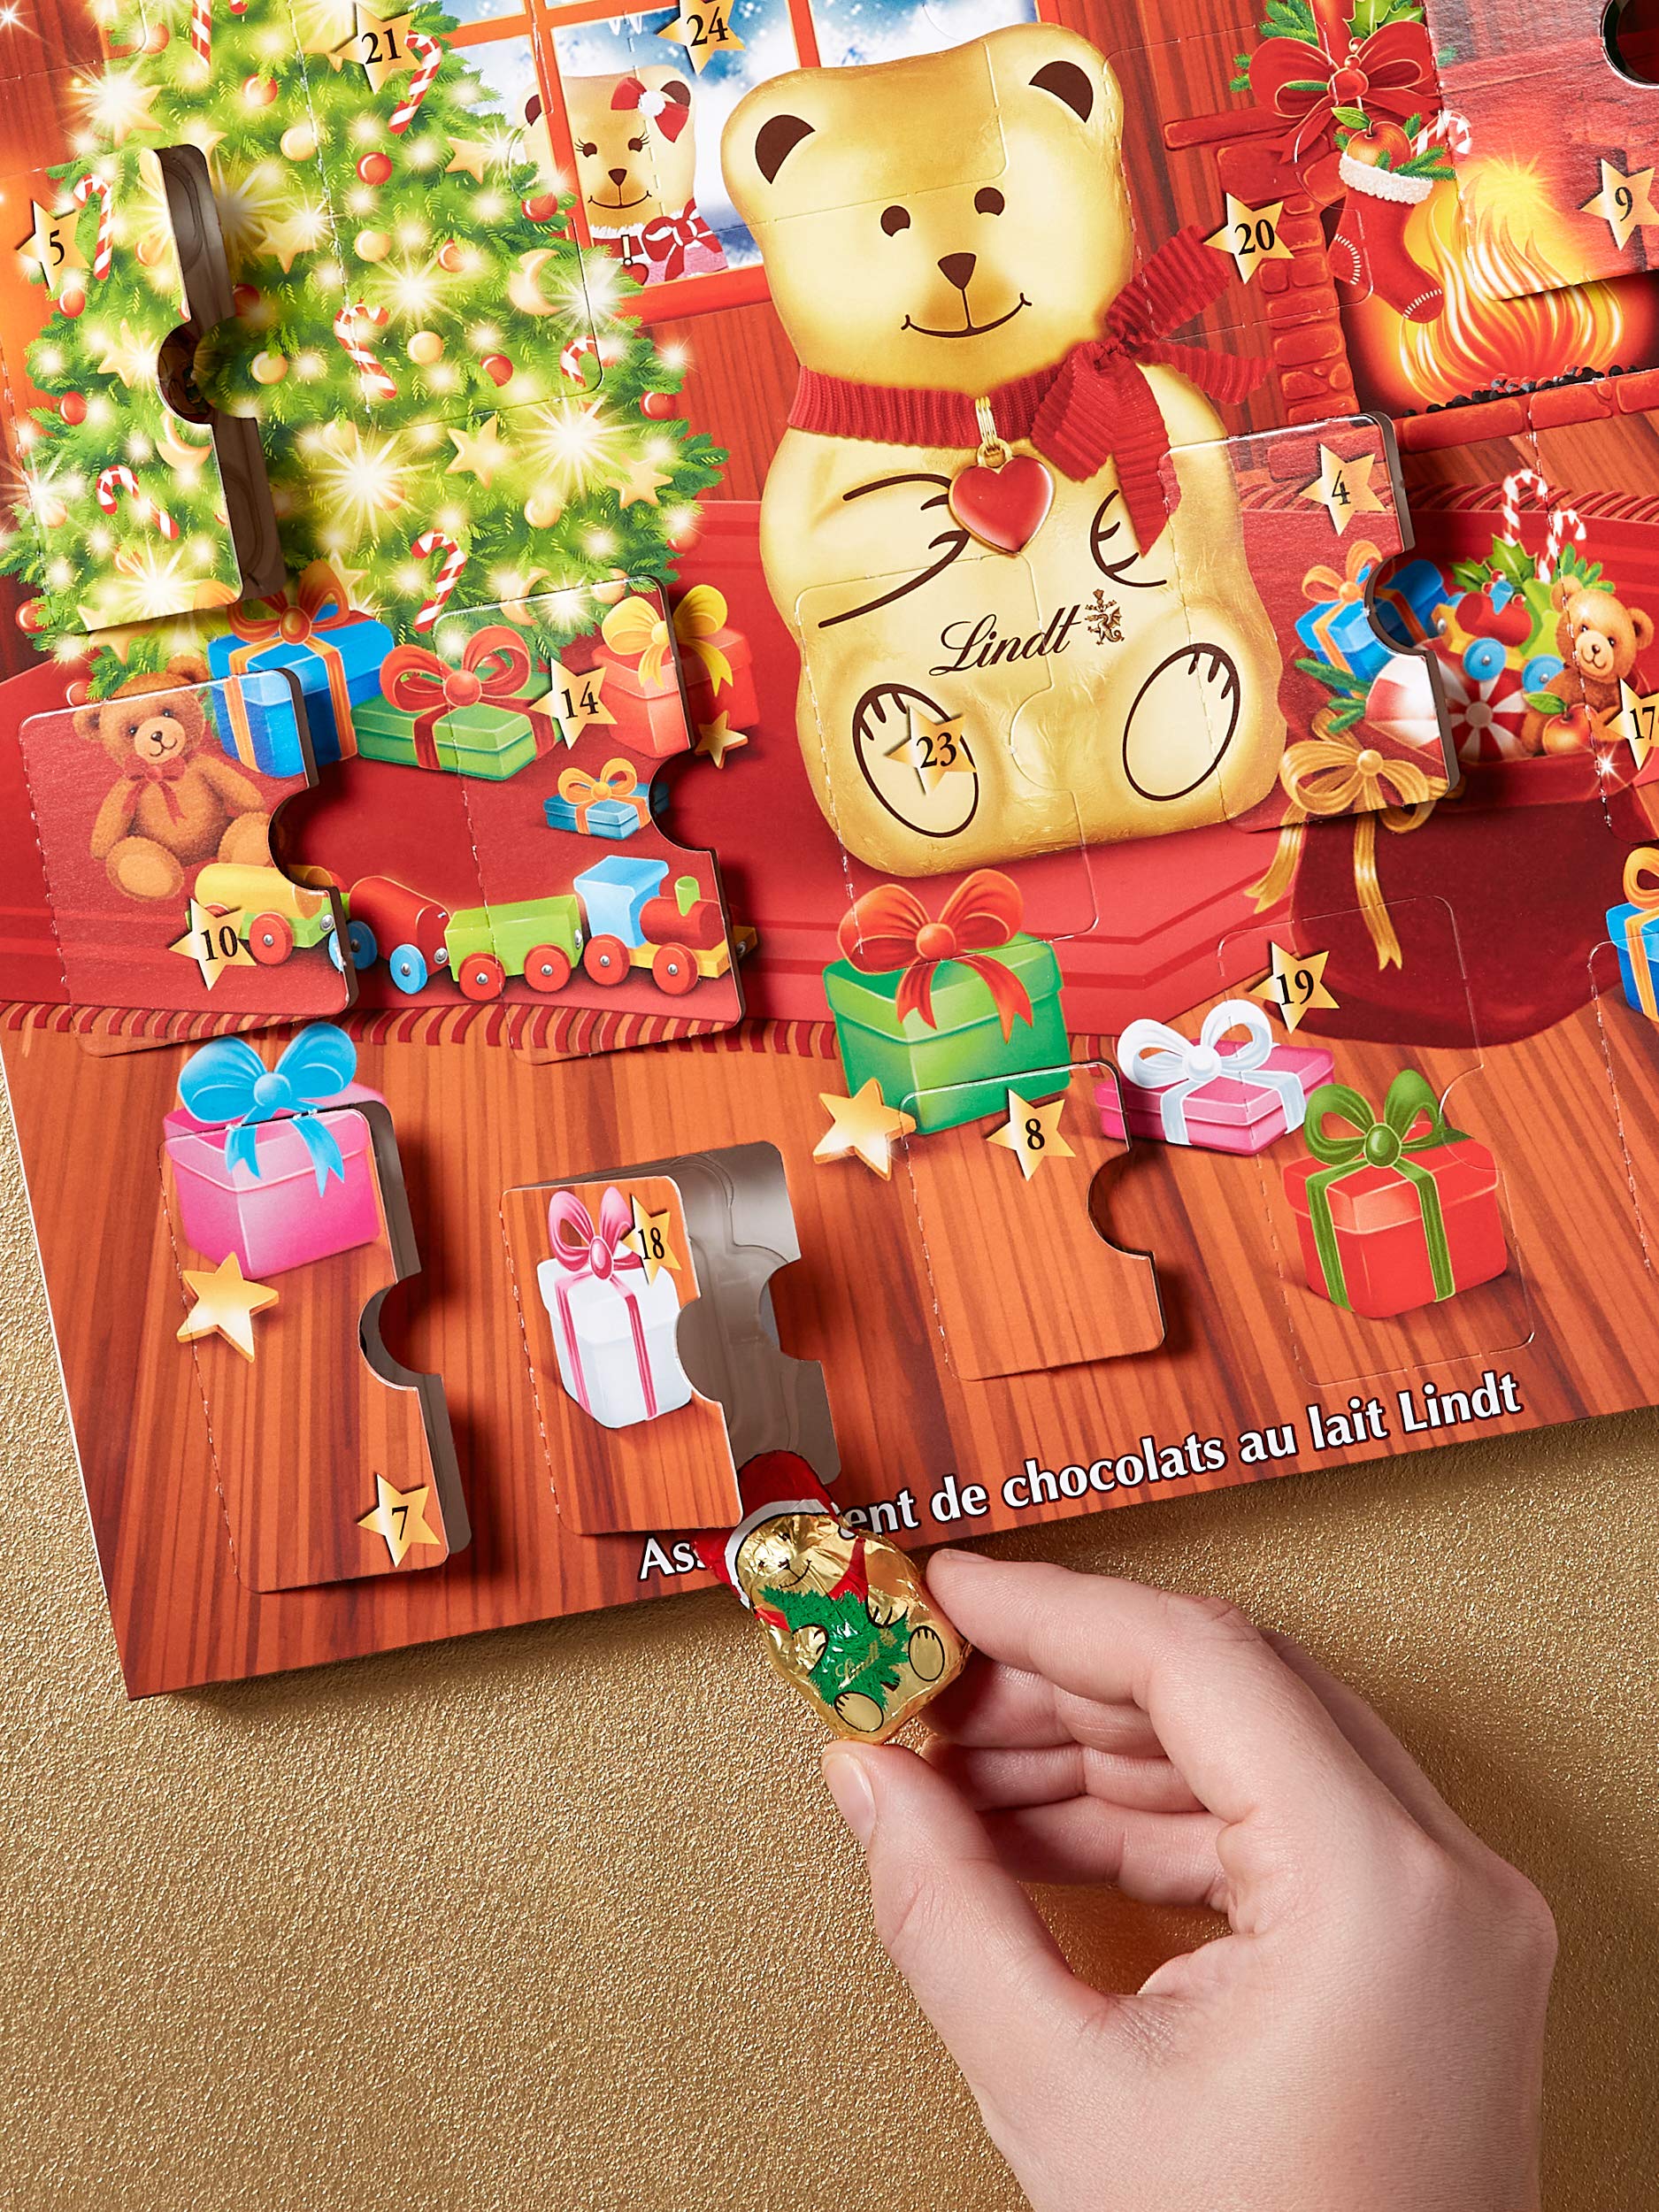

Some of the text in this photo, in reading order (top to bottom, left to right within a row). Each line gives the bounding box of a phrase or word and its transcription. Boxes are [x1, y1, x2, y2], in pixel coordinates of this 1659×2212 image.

[686, 6, 730, 47] 24
[360, 27, 402, 65] 21
[1615, 185, 1633, 222] 9
[50, 229, 65, 266] 5
[1234, 219, 1275, 257] 20
[1331, 469, 1350, 506] 4
[929, 604, 1082, 676] Lindt
[561, 681, 599, 719] 14
[1629, 705, 1656, 741] 17
[917, 732, 957, 769] 23
[200, 926, 239, 963] 10
[1279, 970, 1315, 1007] 19
[1025, 1118, 1045, 1151] 8
[637, 1225, 665, 1261] 18
[931, 1475, 987, 1523] de
[1002, 1433, 1226, 1508] chocolats
[1239, 1425, 1297, 1463] au
[1307, 1398, 1388, 1450] lait
[1398, 1371, 1522, 1433] Lindt
[390, 1505, 410, 1541] 7
